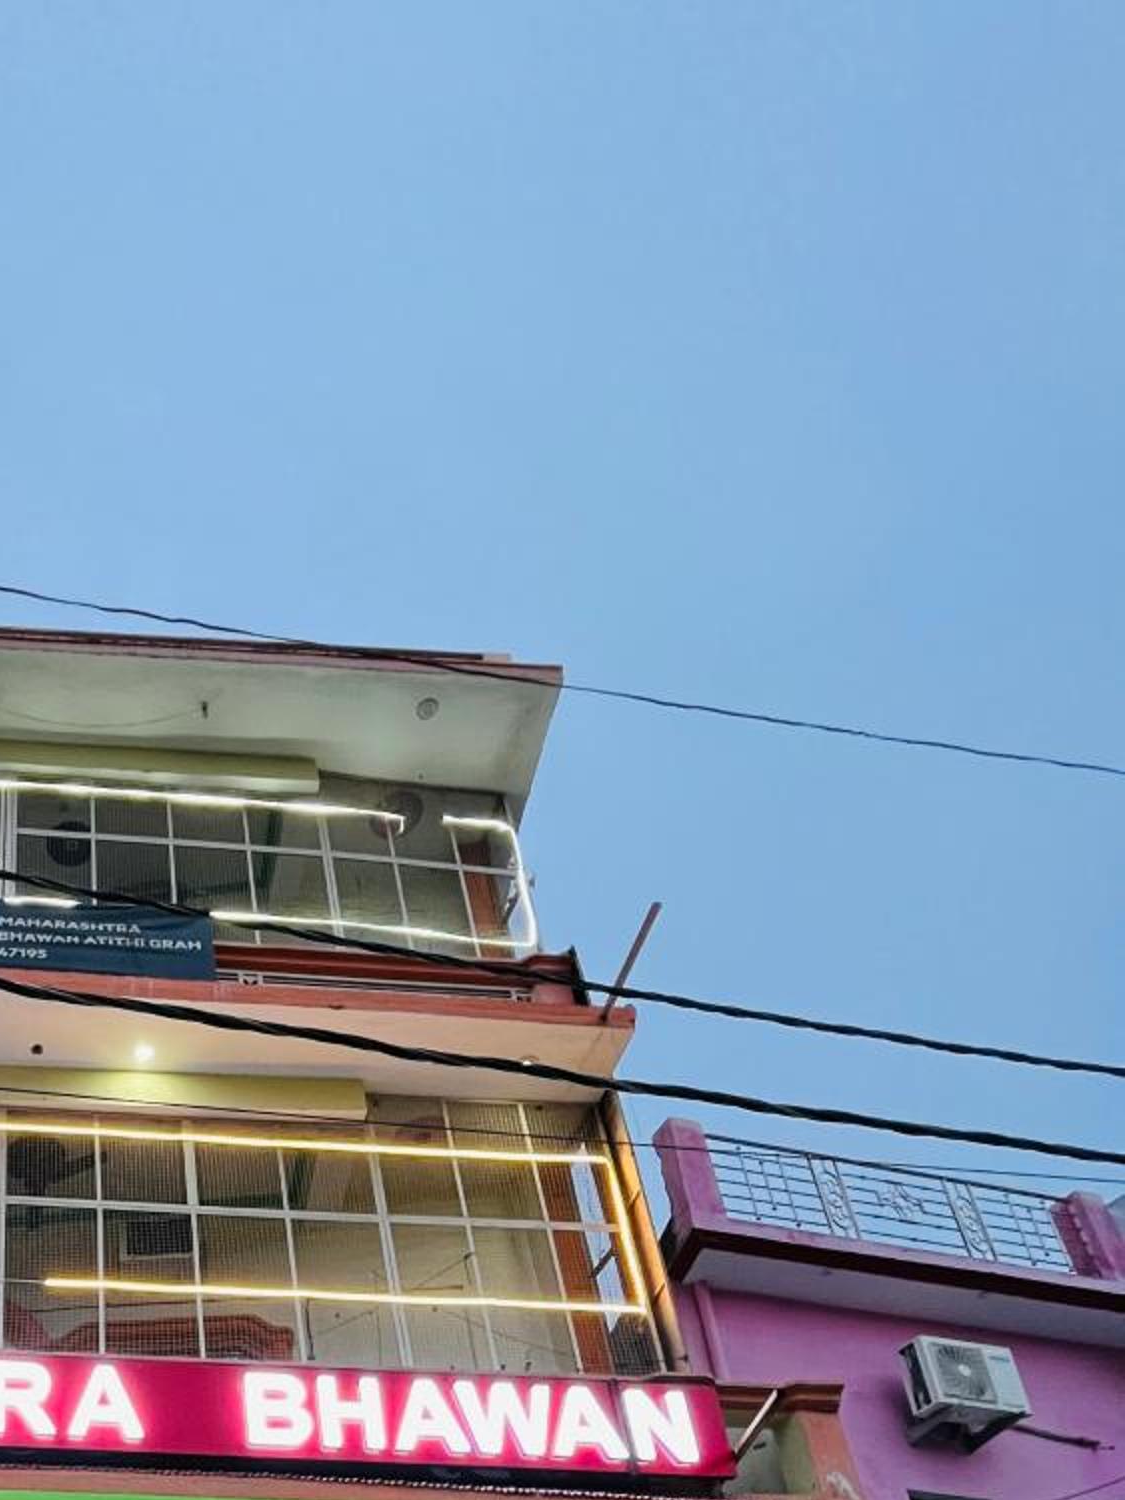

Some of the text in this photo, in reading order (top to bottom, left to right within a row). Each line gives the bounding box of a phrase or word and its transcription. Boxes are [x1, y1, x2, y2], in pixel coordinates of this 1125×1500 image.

[84, 935, 146, 948] ATITHI
[150, 939, 203, 951] GRAH
[241, 1371, 700, 1464] BHAWAN
